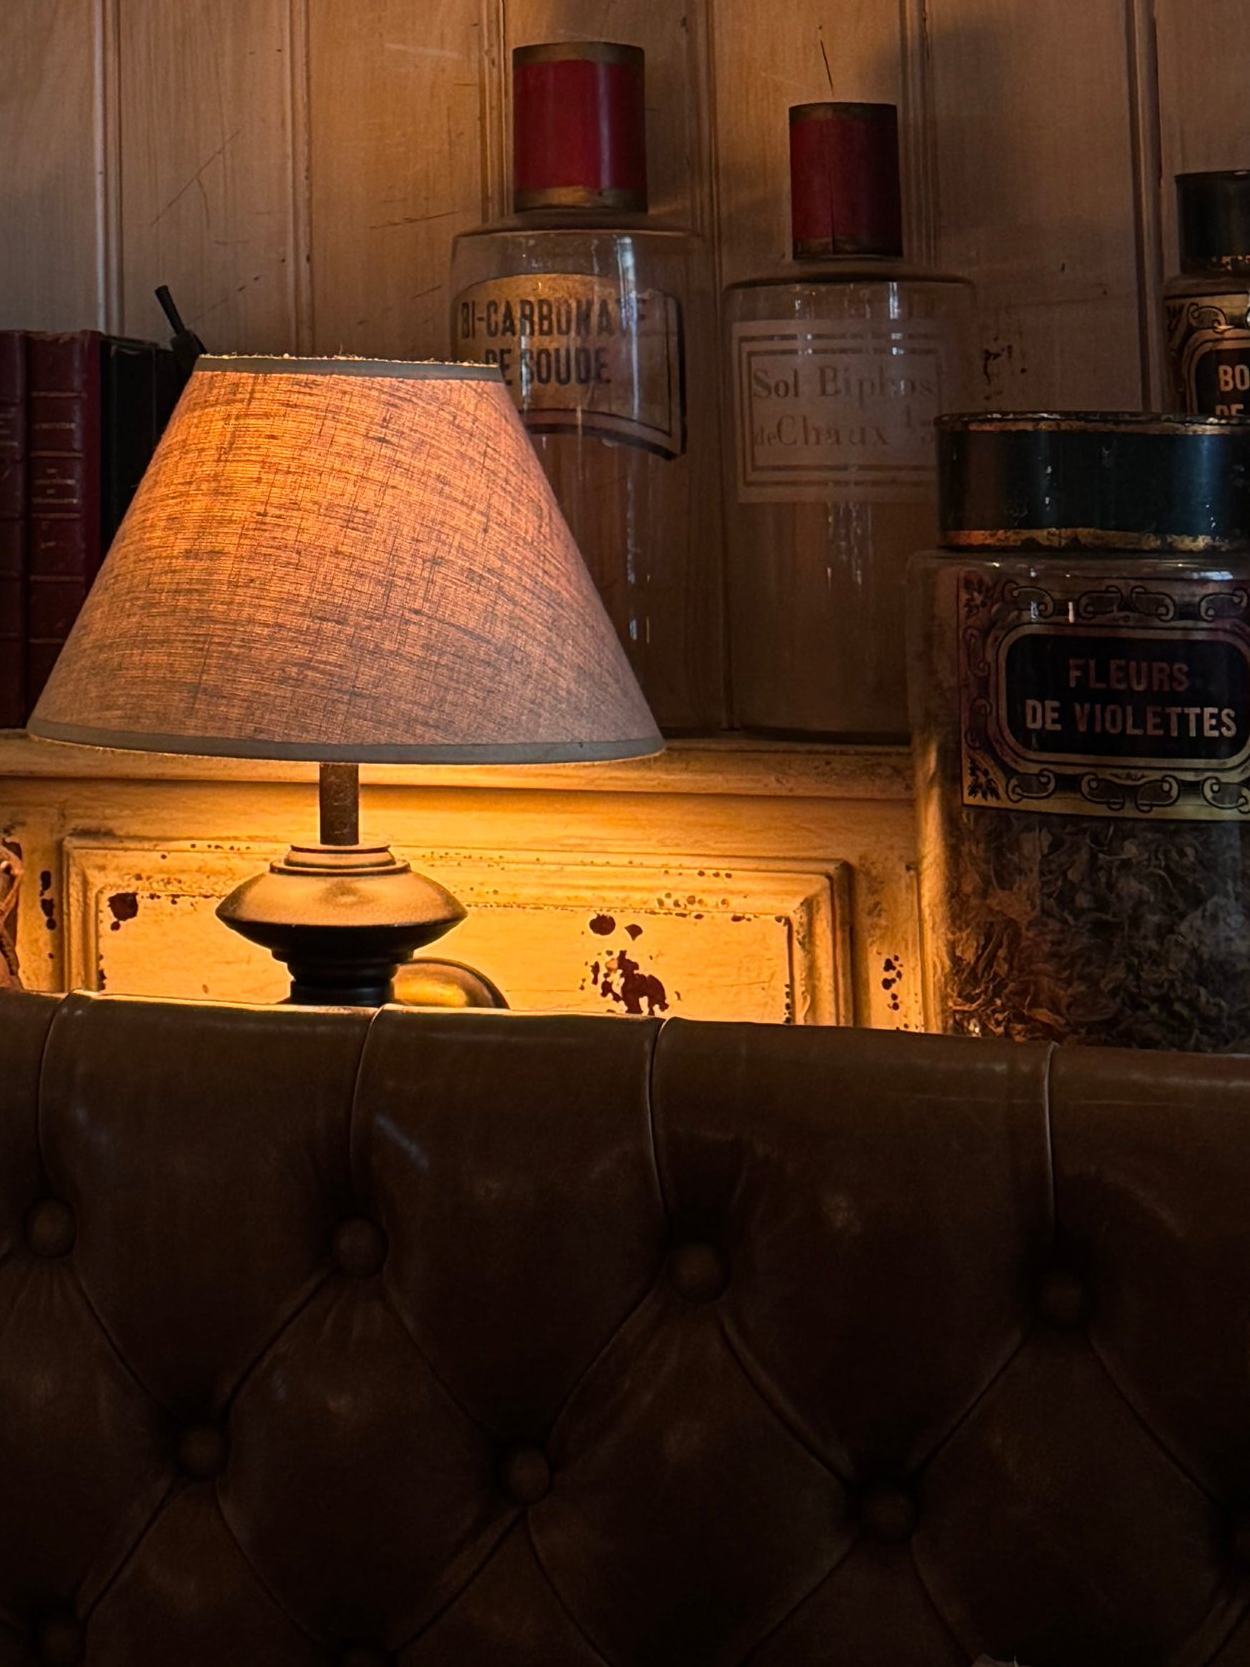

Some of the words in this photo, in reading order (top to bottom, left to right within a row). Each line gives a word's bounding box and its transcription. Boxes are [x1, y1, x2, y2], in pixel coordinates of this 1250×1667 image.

[752, 367, 800, 399] Sol
[777, 404, 890, 447] Chaux
[1067, 657, 1191, 693] FLEURS
[1024, 698, 1063, 732] DE
[1072, 700, 1238, 739] VIOLETTES
